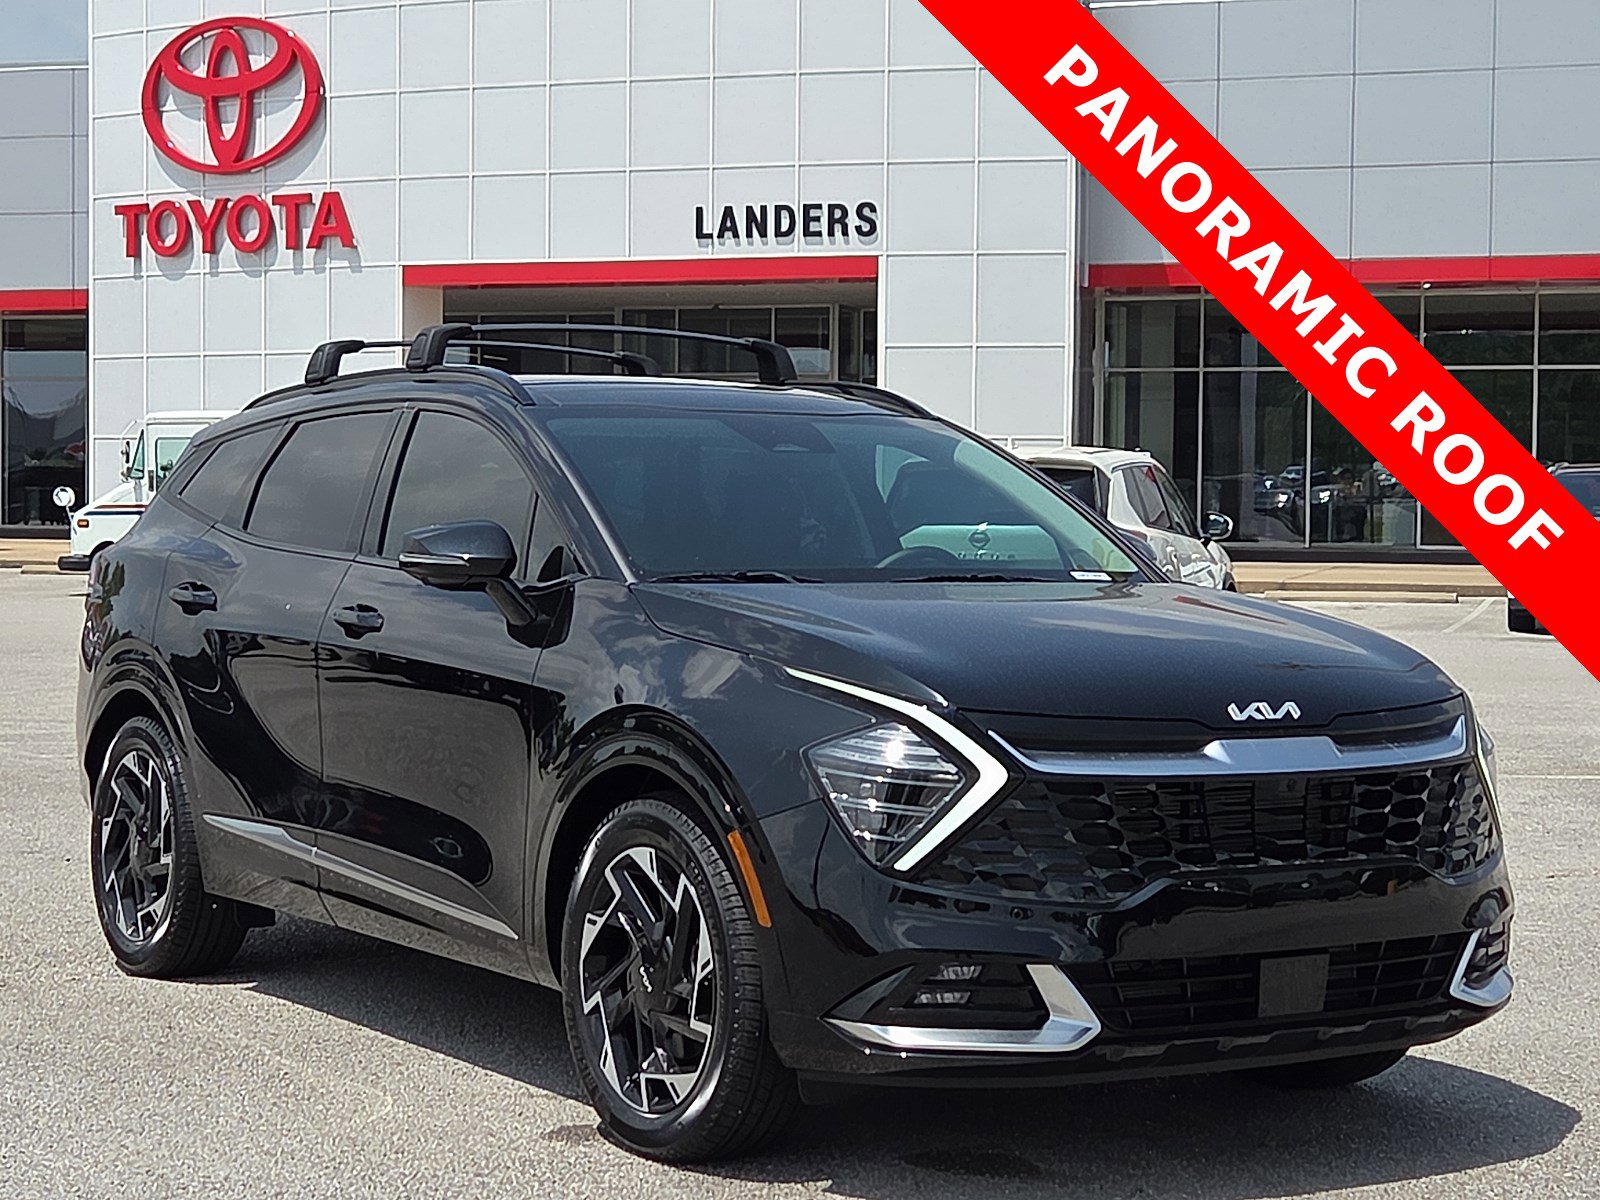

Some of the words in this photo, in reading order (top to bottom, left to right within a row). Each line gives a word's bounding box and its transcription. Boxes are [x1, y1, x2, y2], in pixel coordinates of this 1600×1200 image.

[114, 191, 358, 258] TOYOTA
[695, 201, 878, 240] LANDERS
[1227, 701, 1302, 721] KIA
